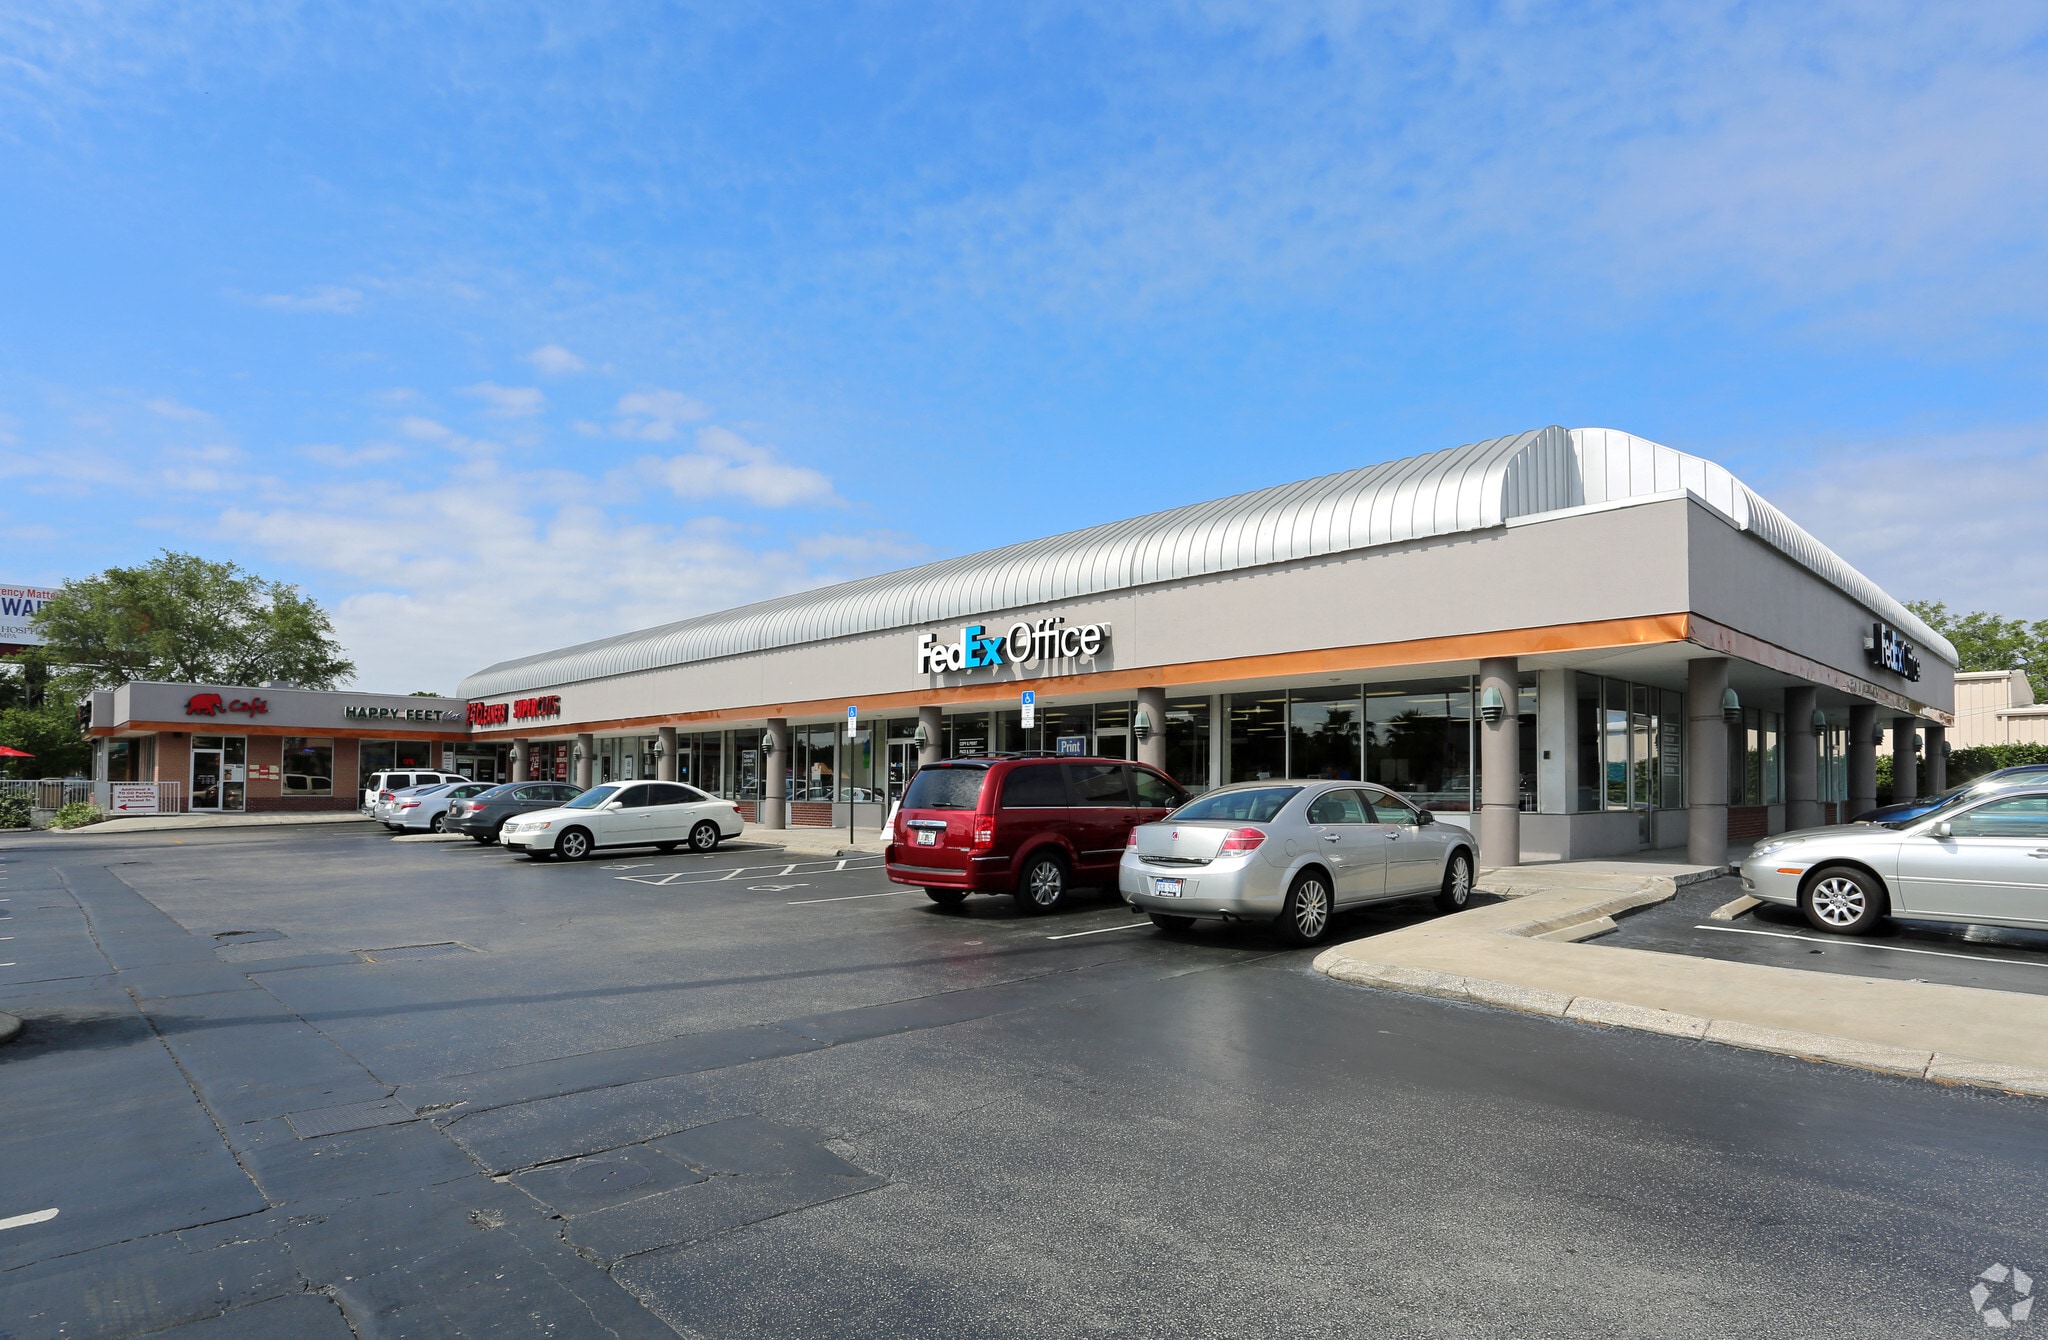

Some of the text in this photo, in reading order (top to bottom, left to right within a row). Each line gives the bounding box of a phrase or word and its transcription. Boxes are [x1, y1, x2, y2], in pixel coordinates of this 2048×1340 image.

[0, 588, 59, 599] ency Matte
[917, 617, 1101, 674] FedEx Office
[344, 706, 399, 719] HAPPY
[405, 709, 443, 721] FEET
[1061, 740, 1081, 755] Print
